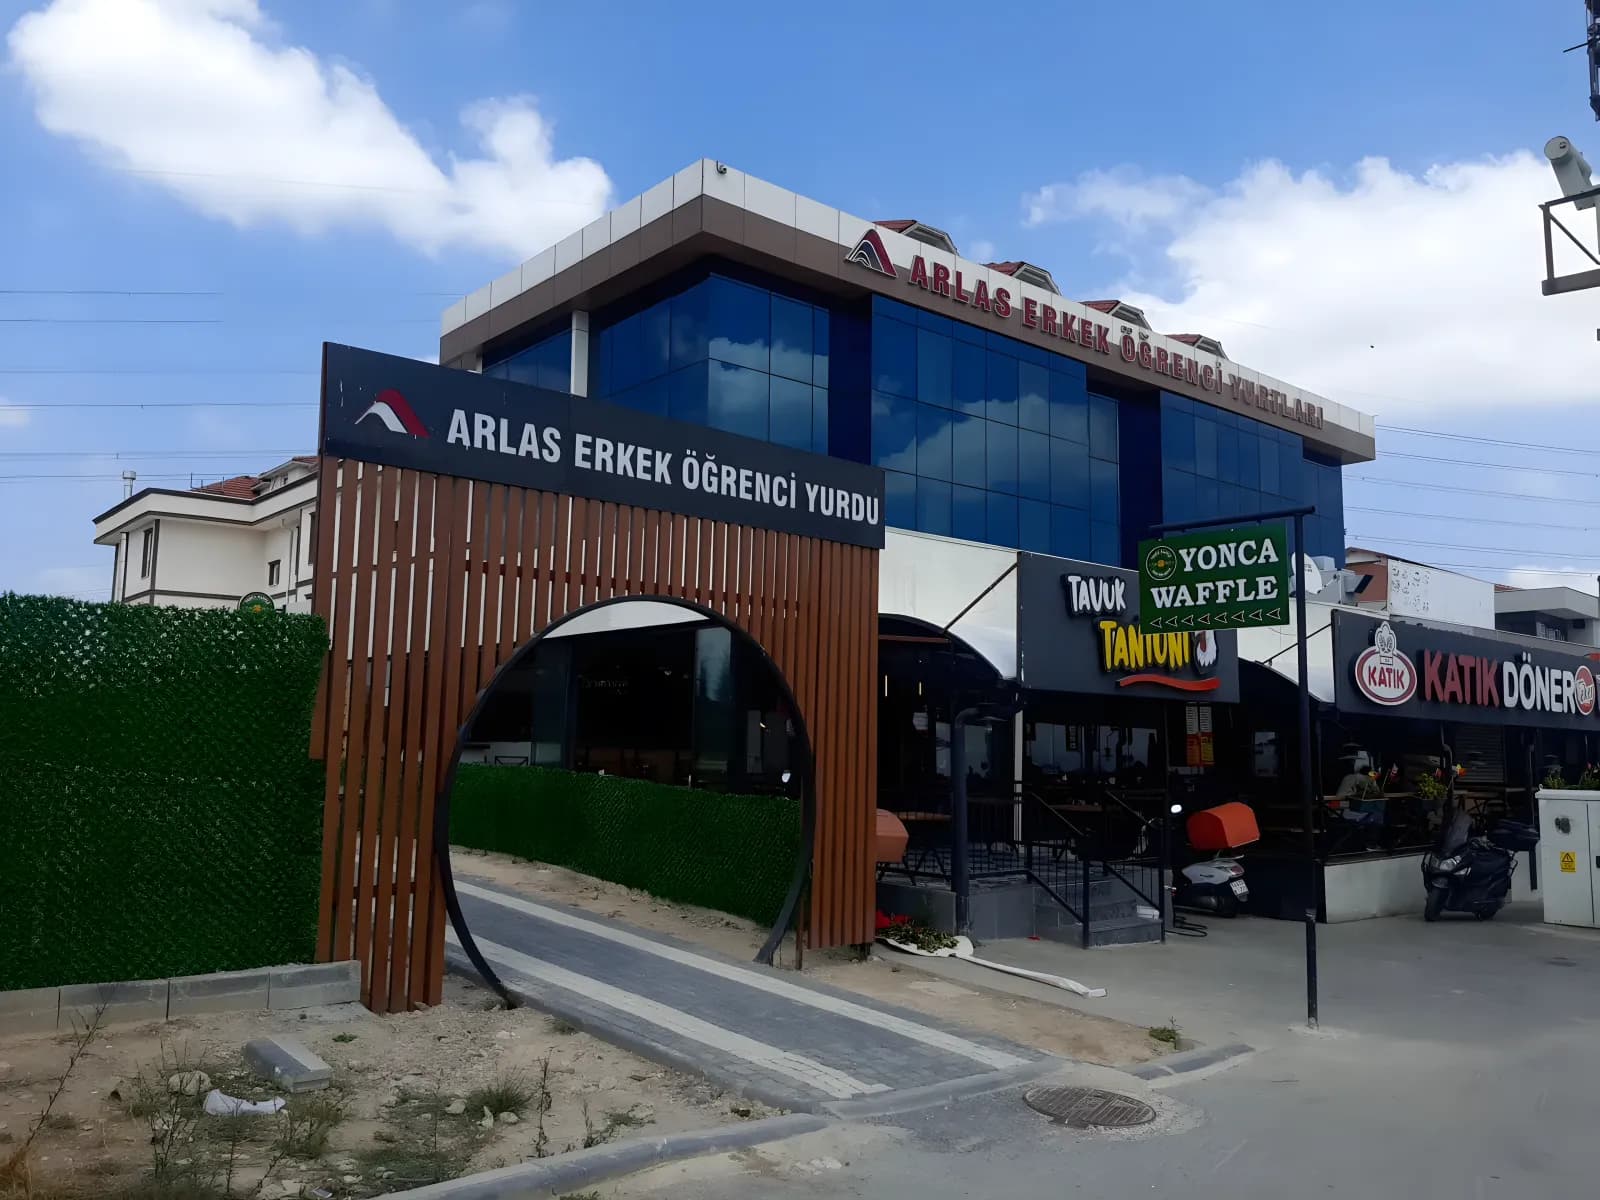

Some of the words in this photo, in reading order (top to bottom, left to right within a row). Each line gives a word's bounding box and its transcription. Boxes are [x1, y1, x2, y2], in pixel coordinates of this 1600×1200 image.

[908, 255, 1012, 318] ARLAS
[1022, 297, 1110, 354] ERKEK
[1120, 325, 1223, 394] ÖĞRENCİ
[1229, 373, 1325, 430] YURTLARI
[447, 408, 561, 464] ARLAS
[574, 434, 673, 486] ERKEK
[682, 449, 797, 510] ÖĞRENCİ
[804, 483, 880, 526] YURDU
[1178, 538, 1280, 573] YONCA
[1067, 575, 1127, 613] TAVUK
[1150, 576, 1279, 609] WAFFLE
[1368, 665, 1406, 690] KATIK
[1423, 648, 1500, 708] KATIK
[1503, 651, 1576, 714] DÖNER
